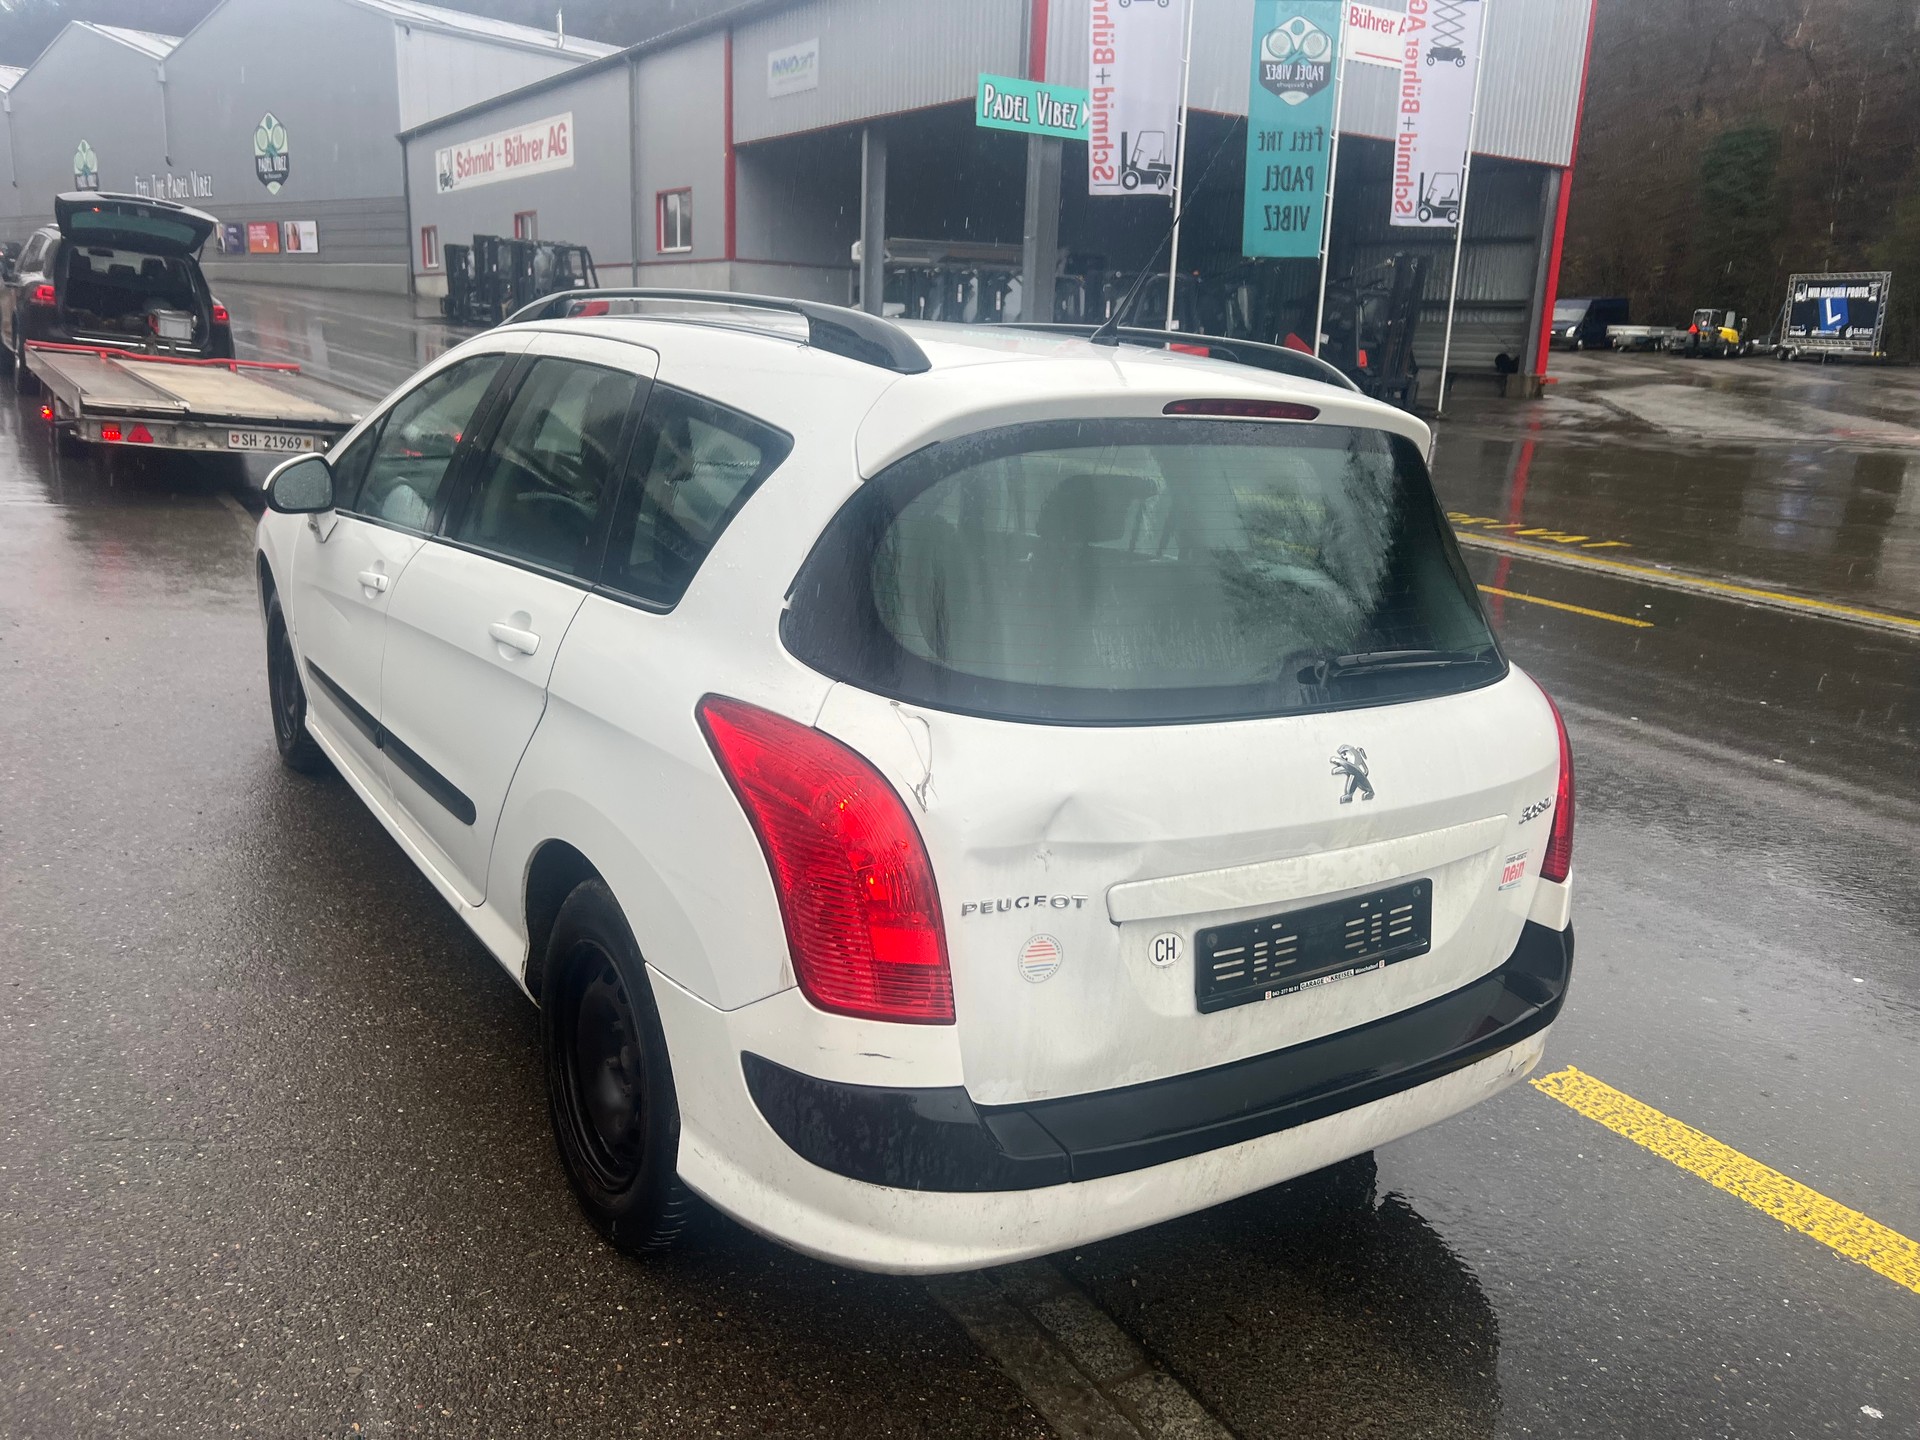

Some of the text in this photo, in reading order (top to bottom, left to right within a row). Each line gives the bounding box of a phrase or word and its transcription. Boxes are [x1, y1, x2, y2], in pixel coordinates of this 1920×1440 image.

[1349, 6, 1395, 34] Bührer
[983, 83, 1079, 131] PADEL VIBEZ
[456, 142, 494, 179] Schmid
[504, 135, 544, 168] Bührer
[547, 122, 567, 158] AG
[241, 433, 302, 450] SH 21969
[1501, 861, 1525, 884] nein
[960, 894, 1089, 917] PEUGEOT
[1155, 936, 1176, 962] CH
[1300, 979, 1324, 990] GARAGE
